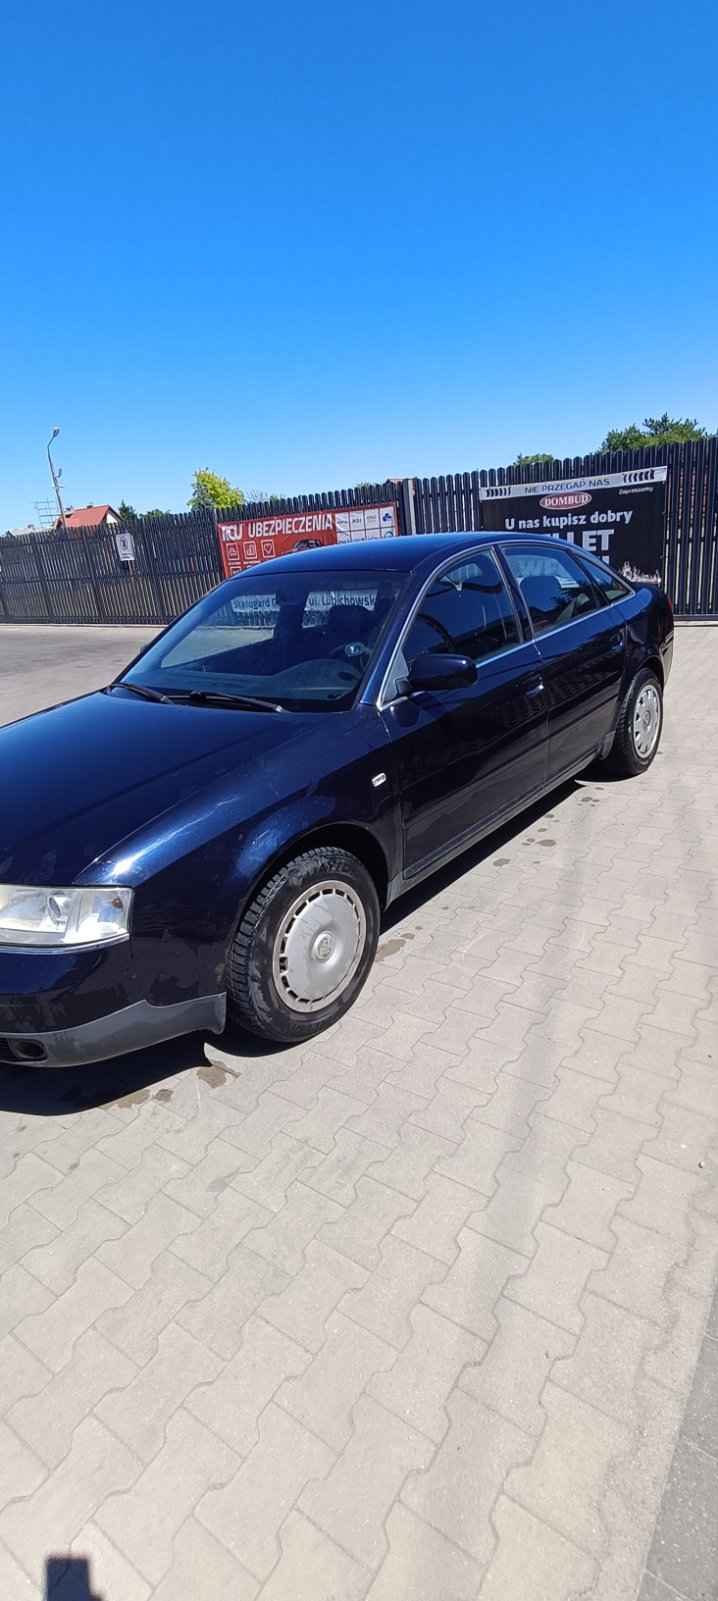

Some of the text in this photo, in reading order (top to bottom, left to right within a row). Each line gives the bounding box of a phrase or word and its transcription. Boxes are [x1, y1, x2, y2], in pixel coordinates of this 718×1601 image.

[524, 479, 610, 494] NIE PRZEGAP NAS
[544, 495, 589, 506] DOMBUD
[248, 513, 333, 538] UBEZPIECZENIA
[505, 510, 633, 529] U nas kupisz dobry
